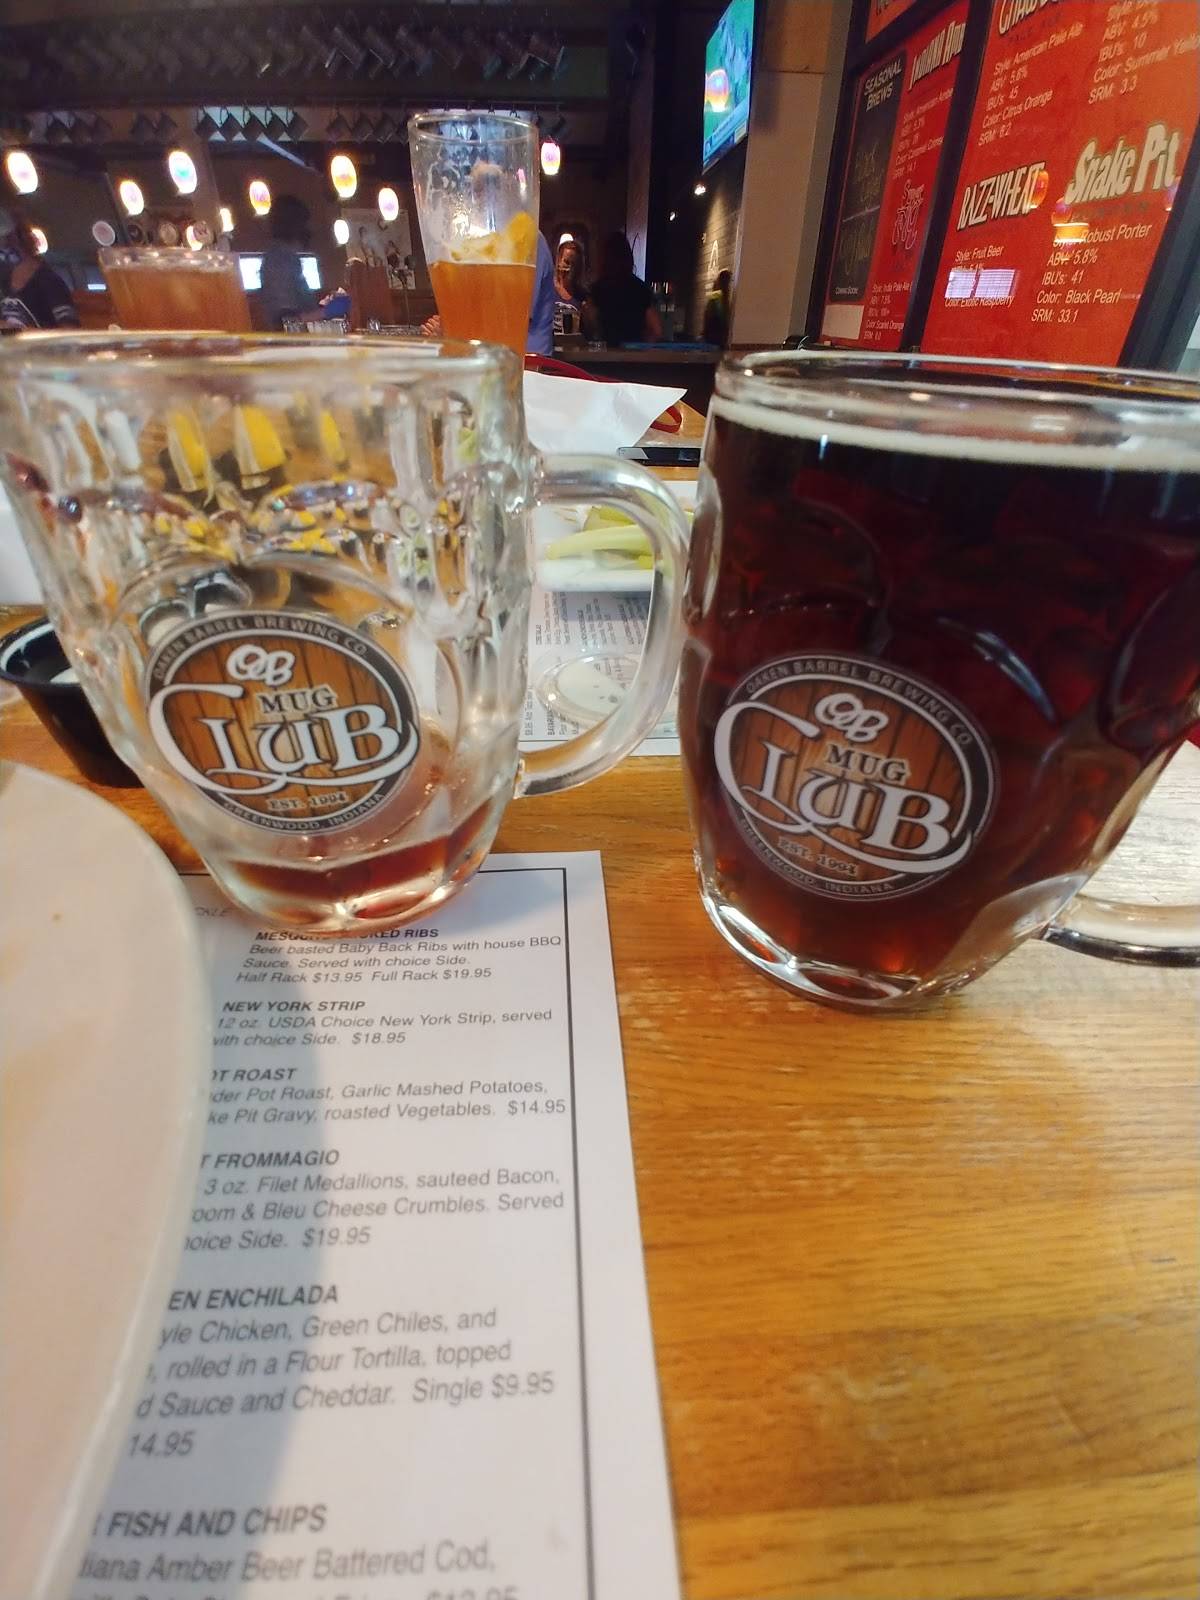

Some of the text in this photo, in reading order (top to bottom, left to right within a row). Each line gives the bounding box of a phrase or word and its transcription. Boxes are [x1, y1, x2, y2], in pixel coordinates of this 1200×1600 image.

[1133, 31, 1147, 49] 10
[1012, 41, 1048, 66] American
[1123, 45, 1172, 73] Summer
[864, 57, 903, 94] SEASONAL
[1119, 74, 1138, 95] 3.3
[866, 82, 894, 112] BREWS
[1023, 89, 1054, 112] Orange
[1063, 123, 1182, 206] Snake Pit
[957, 160, 1046, 232] RAZZ-WHEAT
[1079, 222, 1154, 244] Robust Porter
[954, 244, 1005, 264] Style: Fruit Beer
[1046, 247, 1099, 267] ABV: 5.8%
[1041, 268, 1085, 286] IBU's: 41
[1036, 287, 1123, 305] Color: Black Pearl
[1030, 308, 1079, 323] SRM: 33.1
[186, 614, 249, 643] BARREL
[252, 613, 340, 643] BREWING
[255, 684, 337, 715] MUG
[744, 666, 789, 694] OAKEN
[792, 659, 862, 679] BARREL
[865, 665, 951, 720] BREWING
[150, 683, 420, 796] CLUB
[824, 743, 911, 785] MUG
[713, 701, 973, 874] CLUB
[266, 798, 307, 812] EST.
[327, 793, 388, 828] INDIANA
[823, 881, 895, 895] INDIANA
[404, 928, 440, 938] RIBS
[249, 936, 562, 956] Beer basted Baby Back Ribs with house BBQ
[243, 955, 471, 969] Sauce. Served with choice Side.
[236, 968, 492, 984] Half Rack $13.95 Full Rack $19.95
[217, 1017, 236, 1030] 12
[268, 1016, 317, 1029] USDA
[321, 1015, 375, 1028] Choice
[379, 1014, 414, 1027] New
[419, 1013, 452, 1026] York
[457, 1011, 496, 1026] Strip,
[501, 1008, 553, 1021] served
[222, 1001, 366, 1013] NEW YORK STRIP
[243, 1031, 406, 1047] choice Side. $18.95
[232, 1067, 299, 1082] ROAST
[246, 1080, 549, 1102] Pot Roast, Garlic Mashed Potatoes,
[233, 1109, 260, 1124] Pit
[263, 1108, 318, 1125] Gravy,
[324, 1105, 391, 1121] roasted
[397, 1101, 496, 1122] Vegetables.
[507, 1098, 567, 1116] $14.95
[213, 1149, 341, 1169] FROMMAGIO
[203, 1178, 218, 1196] 3
[256, 1175, 299, 1194] Filet
[302, 1172, 410, 1194] Medallions,
[415, 1169, 491, 1189] sauteed
[496, 1167, 561, 1187] Bacon,
[240, 1202, 256, 1221] &
[262, 1201, 307, 1221] Bleu
[312, 1199, 388, 1219] Cheese
[394, 1195, 490, 1216] Crumbles.
[497, 1191, 565, 1212] Served
[237, 1229, 288, 1251] Side.
[301, 1225, 372, 1249] $19.95
[205, 1284, 339, 1311] ENCHILADA
[199, 1319, 293, 1344] Chicken,
[302, 1314, 369, 1339] Green
[376, 1310, 449, 1335] Chiles,
[456, 1306, 498, 1332] and
[167, 1354, 233, 1380] rolled
[236, 1355, 257, 1377] in
[263, 1357, 278, 1376] a
[285, 1350, 343, 1374] Flour
[351, 1345, 428, 1370] Tortilla,
[435, 1338, 513, 1369] topped
[159, 1391, 234, 1418] Sauce
[240, 1388, 288, 1414] and
[292, 1383, 397, 1411] Cheddar.
[411, 1377, 484, 1407] Single
[490, 1369, 556, 1400] $9.95
[106, 1510, 172, 1537] FISH
[175, 1509, 237, 1537] AND
[243, 1503, 328, 1534] CHIPS
[145, 1537, 496, 1582] Amber Beer Battered Cod,
